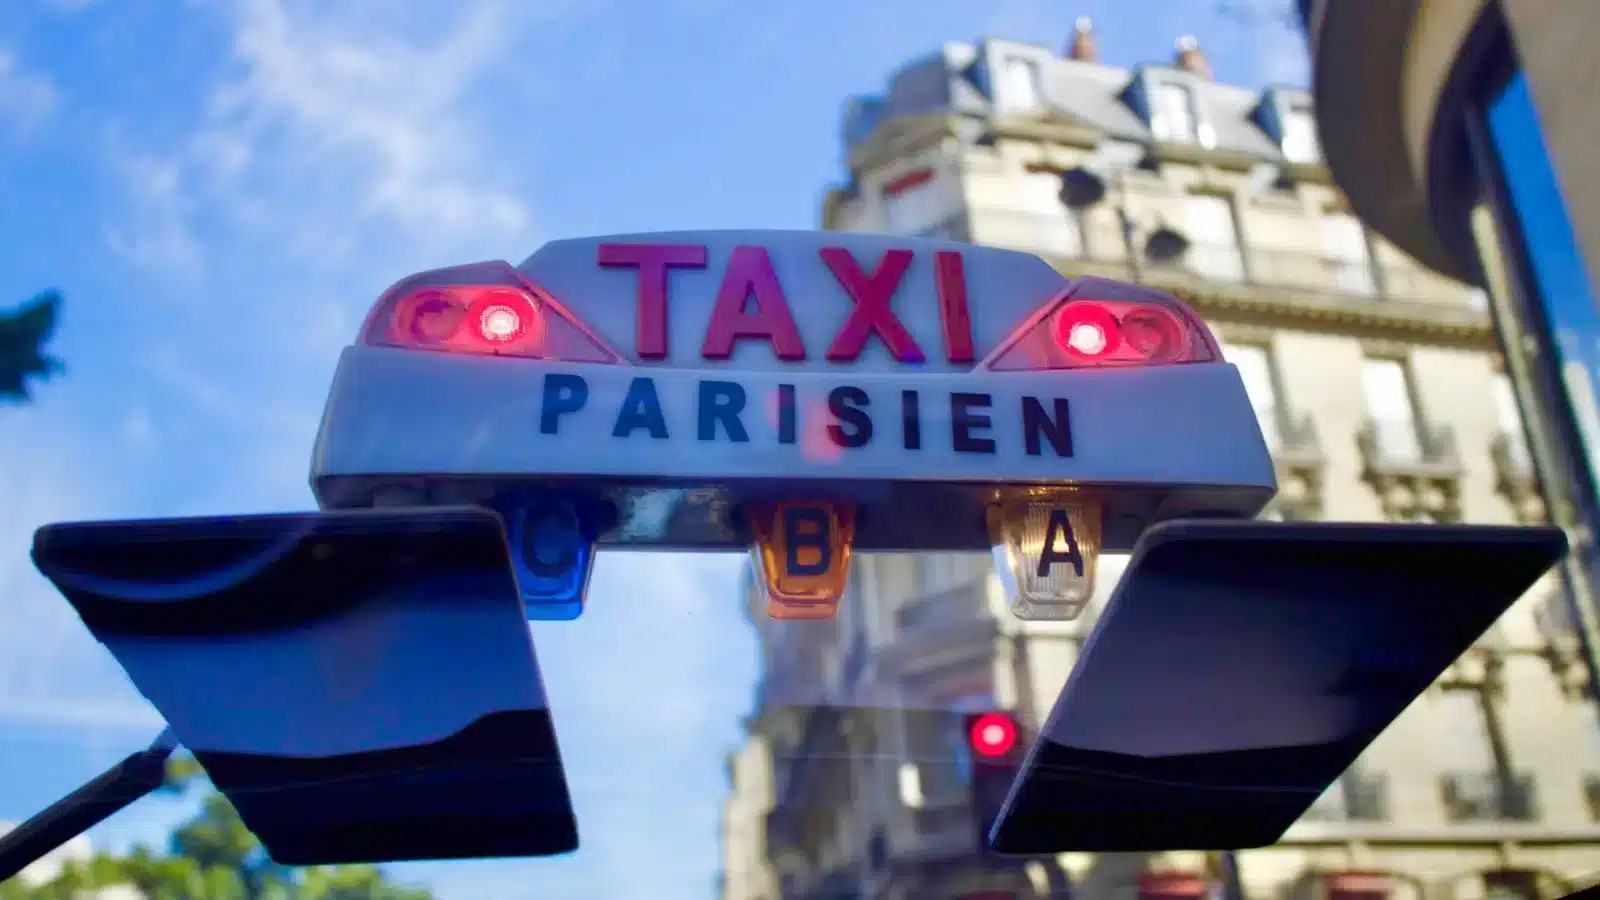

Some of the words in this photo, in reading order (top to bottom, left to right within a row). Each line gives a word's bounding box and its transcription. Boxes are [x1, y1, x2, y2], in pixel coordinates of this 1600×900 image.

[597, 243, 975, 363] TAXI
[540, 373, 1075, 458] PARISIEN
[522, 501, 577, 577] C
[786, 509, 830, 576] B
[1037, 509, 1084, 577] A
